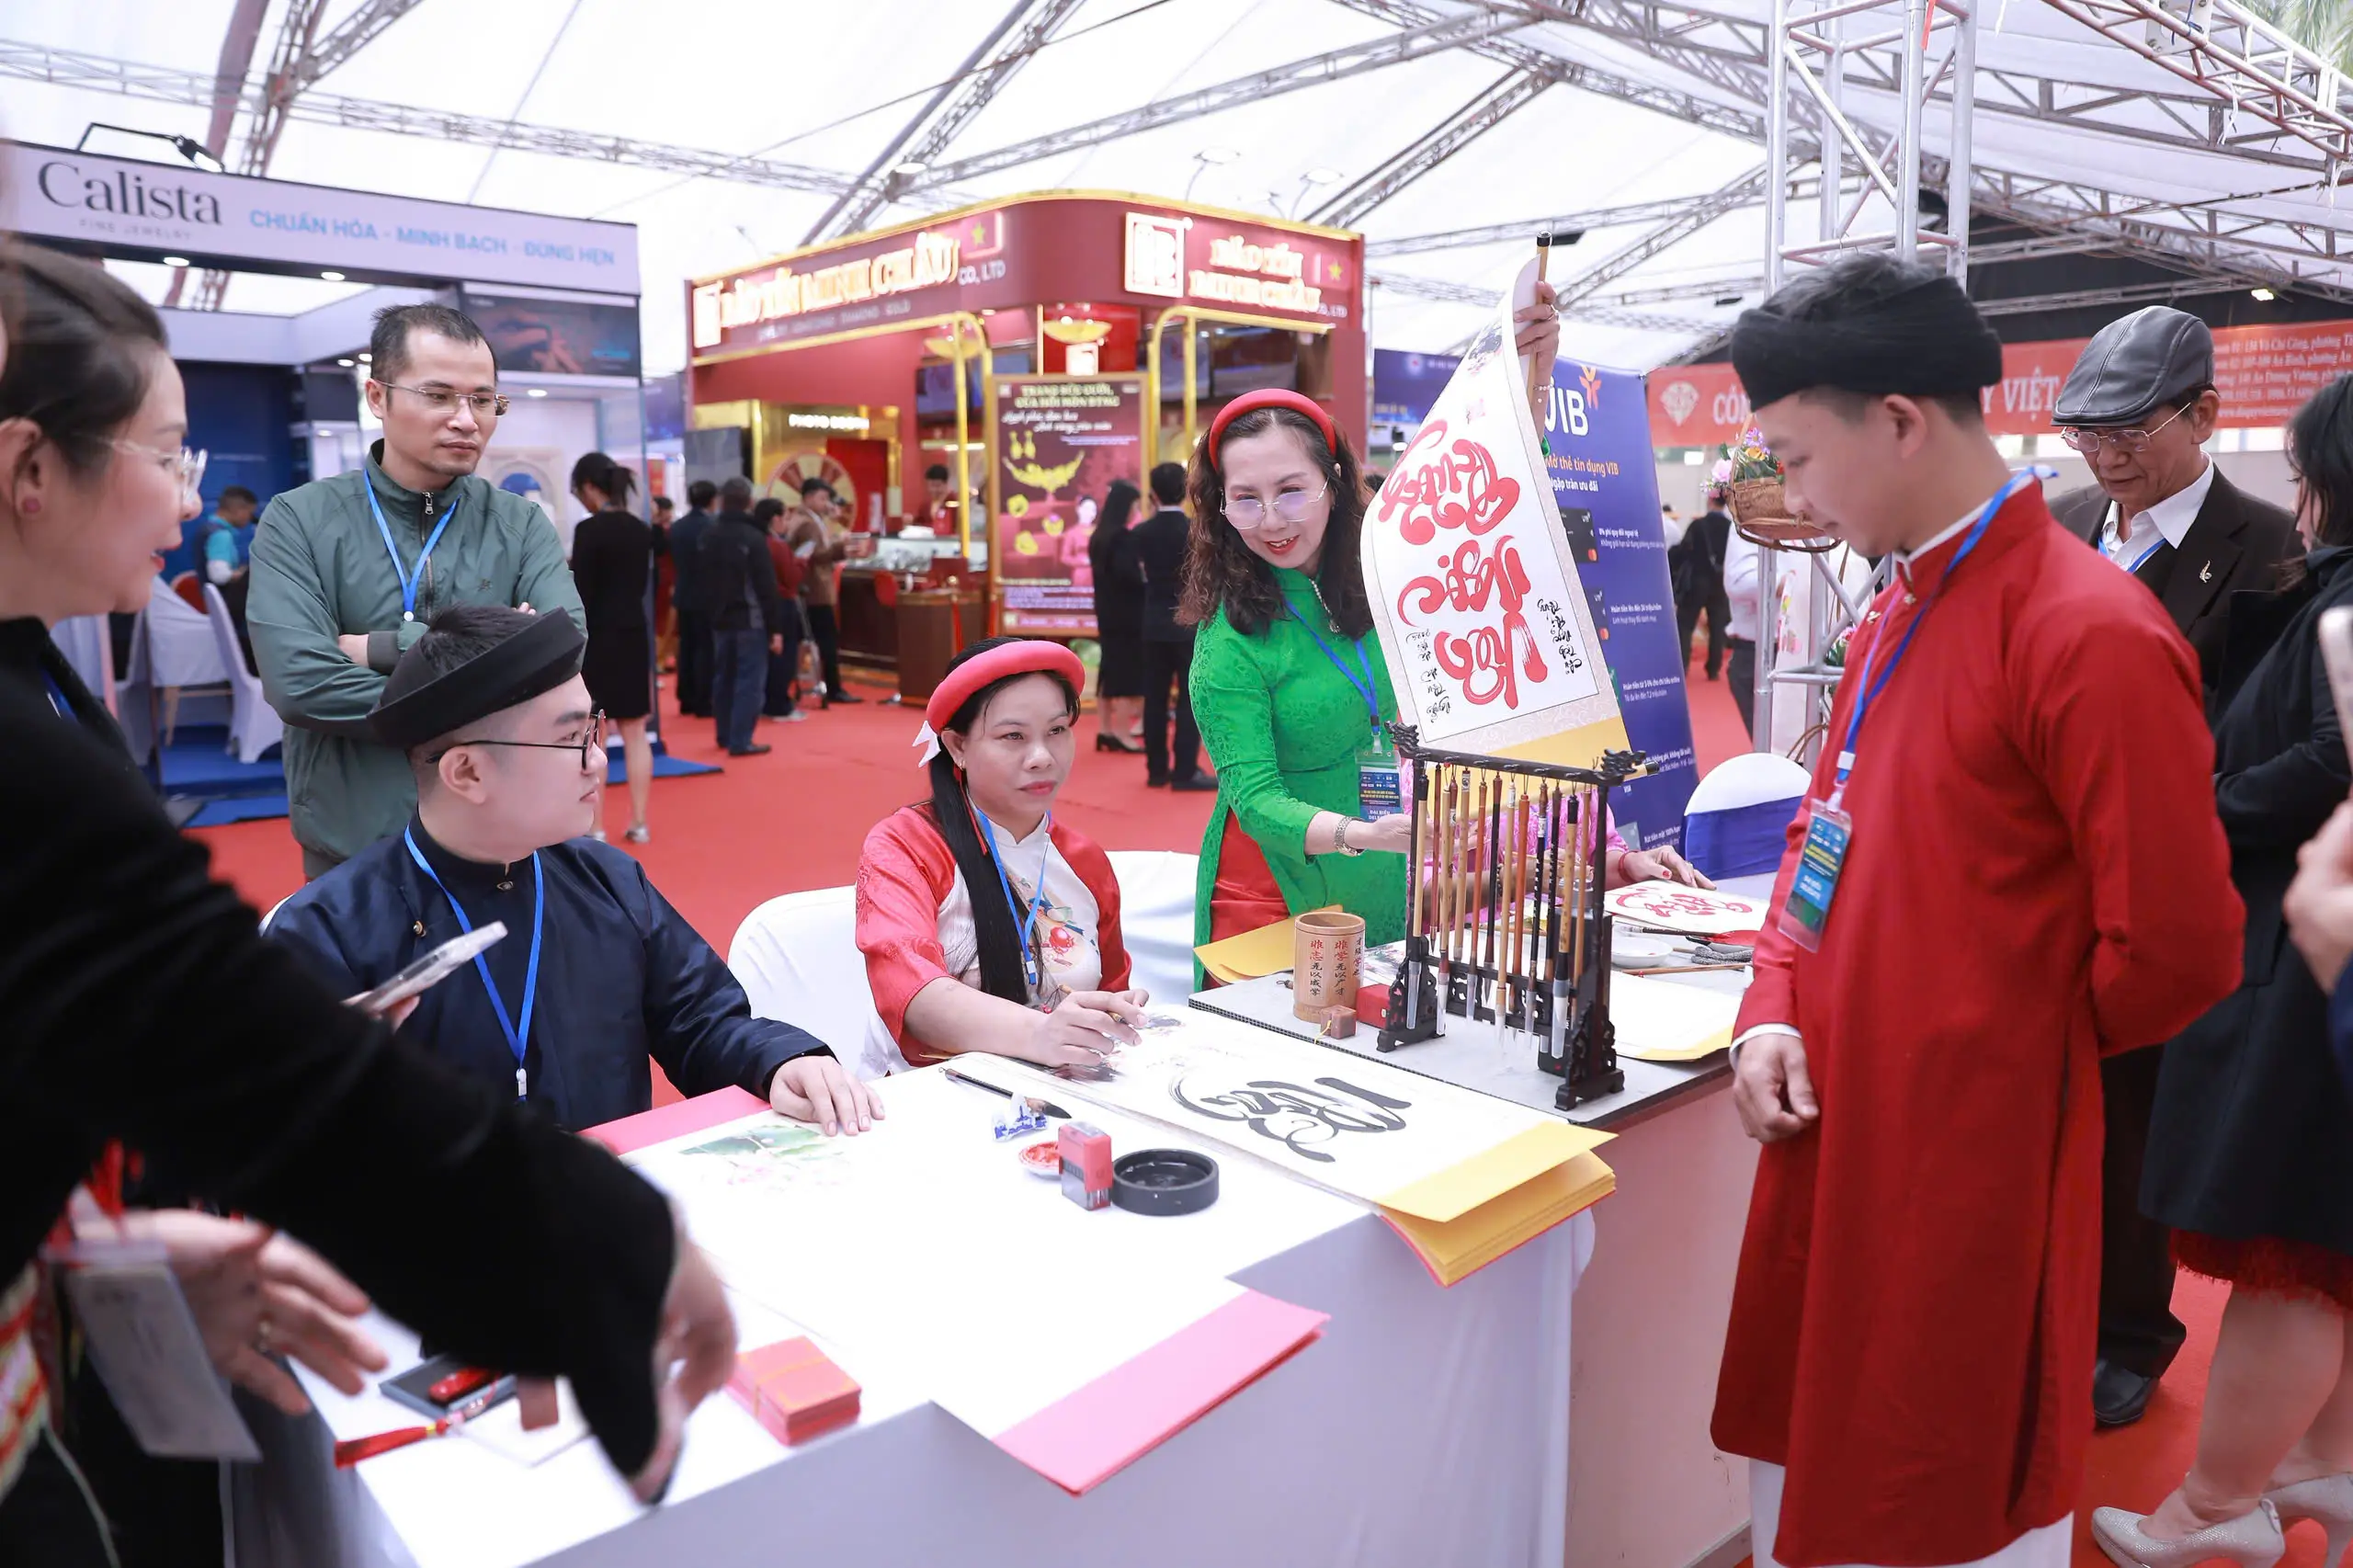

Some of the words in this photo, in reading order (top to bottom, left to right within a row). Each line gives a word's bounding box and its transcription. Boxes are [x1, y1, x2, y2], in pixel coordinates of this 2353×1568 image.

[39, 161, 222, 225] Calista
[396, 225, 450, 246] MINH
[981, 260, 1006, 281] LTD
[2002, 366, 2060, 423] VIỆT
[1559, 455, 1573, 471] thẻ
[1574, 456, 1586, 472] tín
[1586, 459, 1607, 478] dụng
[1606, 461, 1620, 475] VIB
[1565, 477, 1579, 491] tràn
[1578, 481, 1589, 491] ưu
[1589, 479, 1599, 493] đãi
